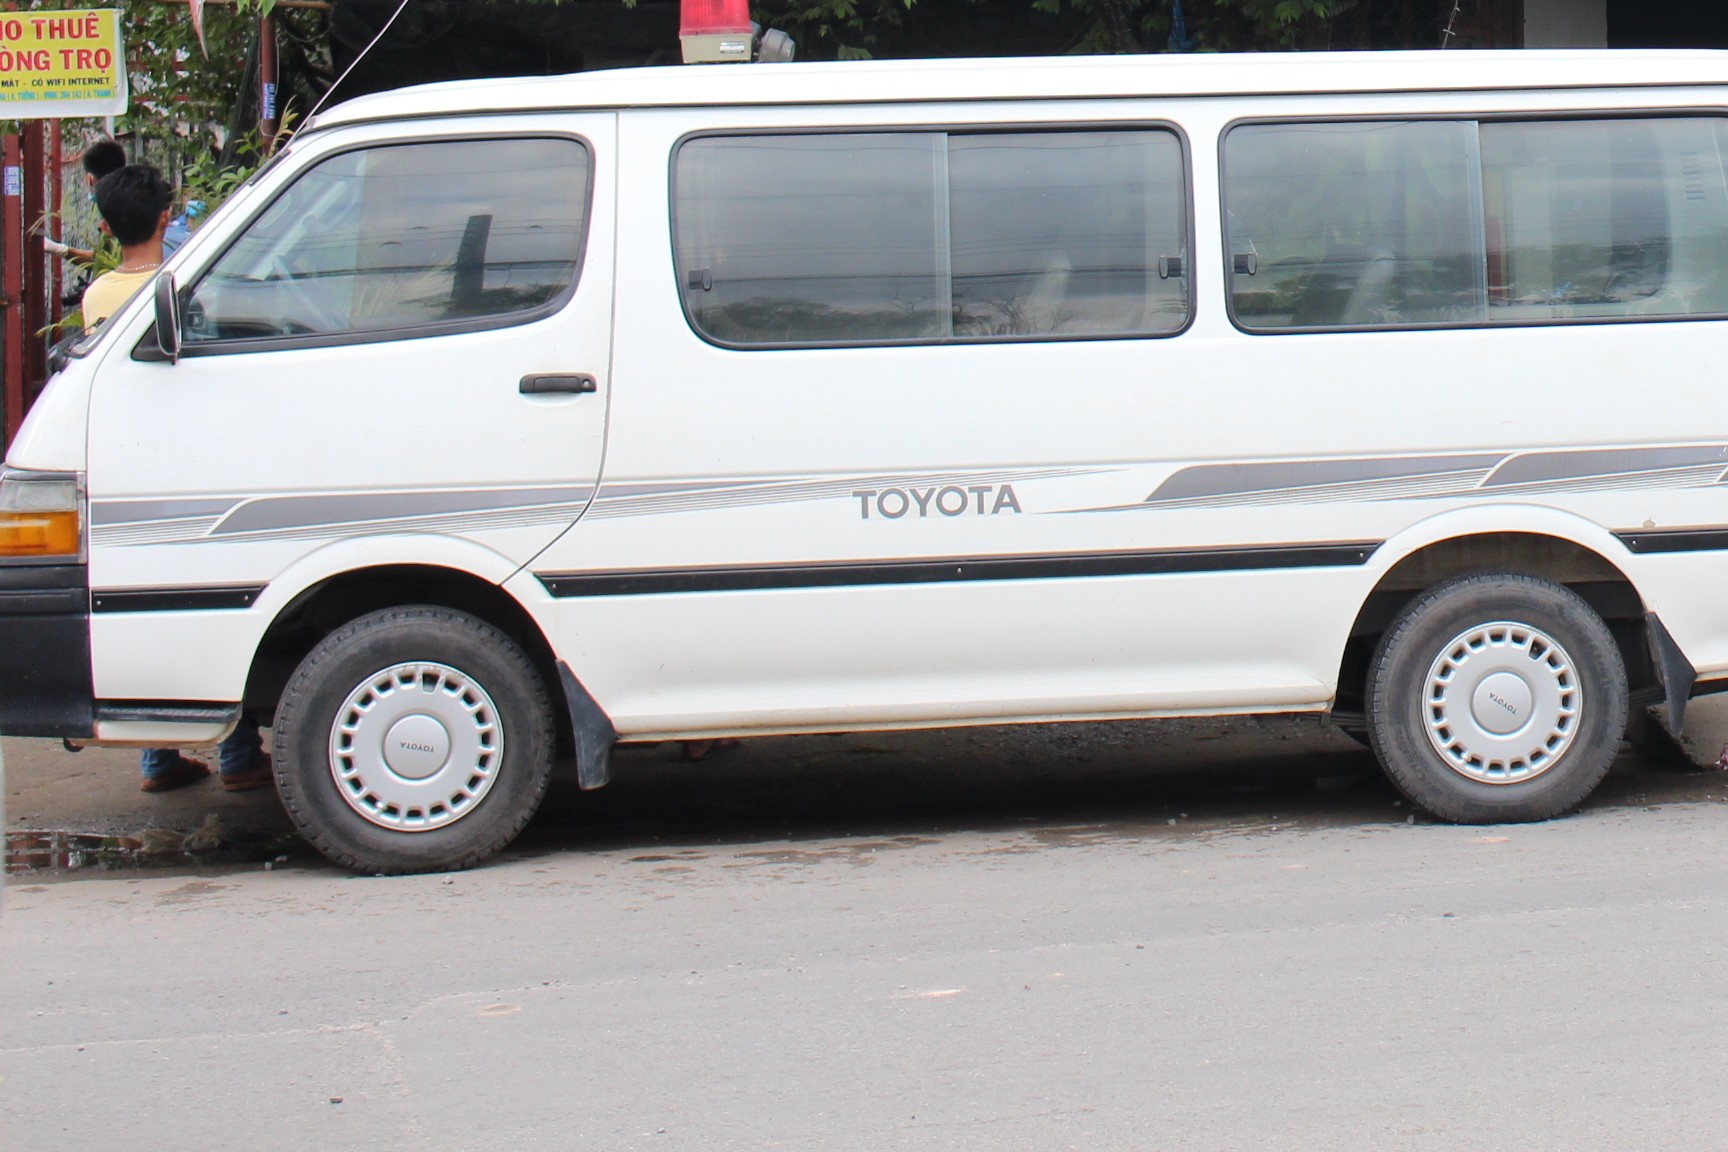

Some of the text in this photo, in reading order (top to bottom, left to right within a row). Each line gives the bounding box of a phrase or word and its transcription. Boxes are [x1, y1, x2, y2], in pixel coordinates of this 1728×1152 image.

[31, 12, 100, 40] THUÊ
[59, 48, 112, 74] TRỌ
[46, 78, 66, 87] WIFI
[69, 77, 110, 86] INTERNET
[852, 484, 1022, 519] TOYOTA
[1489, 692, 1517, 714] TOYOTA
[400, 741, 435, 753] TOYOTA
